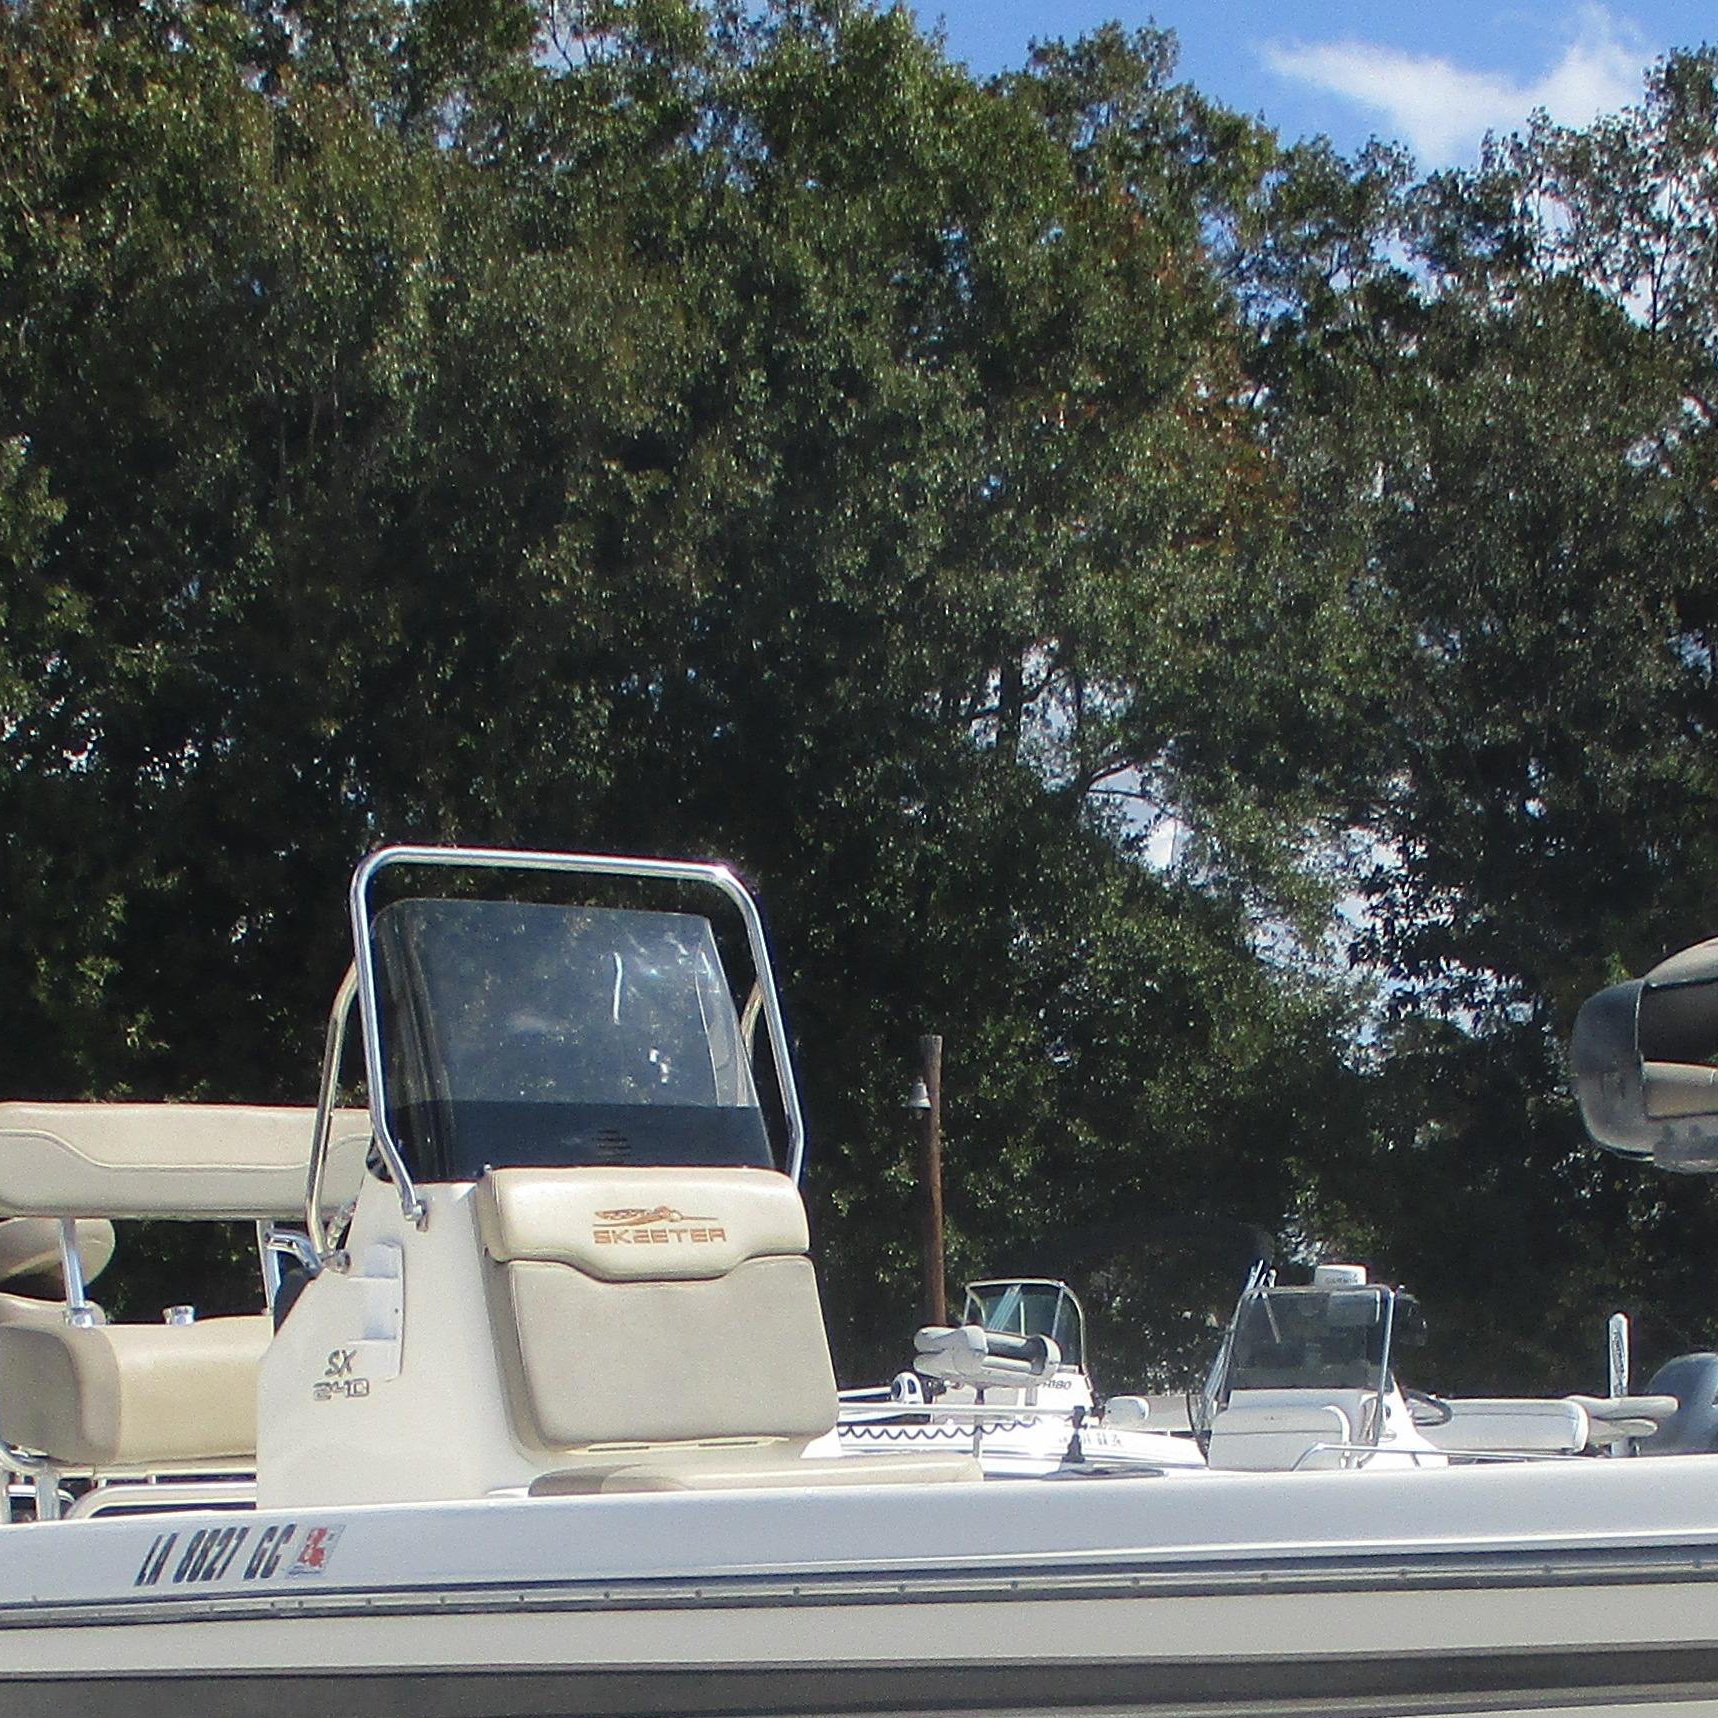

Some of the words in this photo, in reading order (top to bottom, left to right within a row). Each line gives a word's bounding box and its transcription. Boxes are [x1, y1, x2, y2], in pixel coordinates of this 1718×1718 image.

[592, 1227, 727, 1245] SKEETER
[324, 1348, 357, 1378] SX
[313, 1378, 370, 1401] 240
[172, 1525, 251, 1584] 8827
